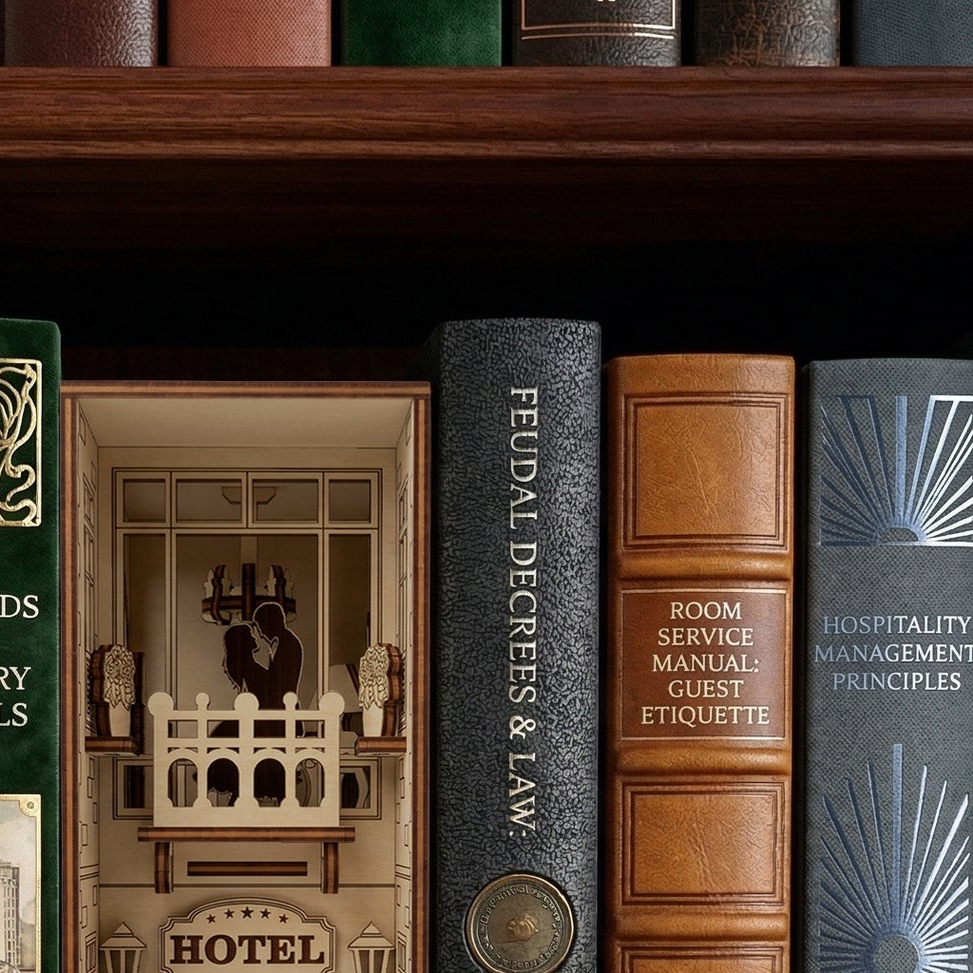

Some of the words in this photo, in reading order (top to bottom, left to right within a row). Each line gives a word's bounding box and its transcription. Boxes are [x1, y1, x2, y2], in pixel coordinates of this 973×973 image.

[510, 386, 538, 530] FEUDAL
[670, 601, 742, 620] ROOM
[509, 540, 537, 704] DECREES
[824, 615, 972, 634] HOSPITALITY
[658, 628, 754, 646] SERVICE
[652, 654, 759, 673] MANUAL:
[668, 680, 744, 698] GUEST
[832, 672, 961, 691] PRINCIPLES
[641, 706, 770, 728] ETIQUETTE
[509, 715, 537, 740] &
[508, 752, 536, 837] LAW:
[169, 934, 325, 965] HOTEL
